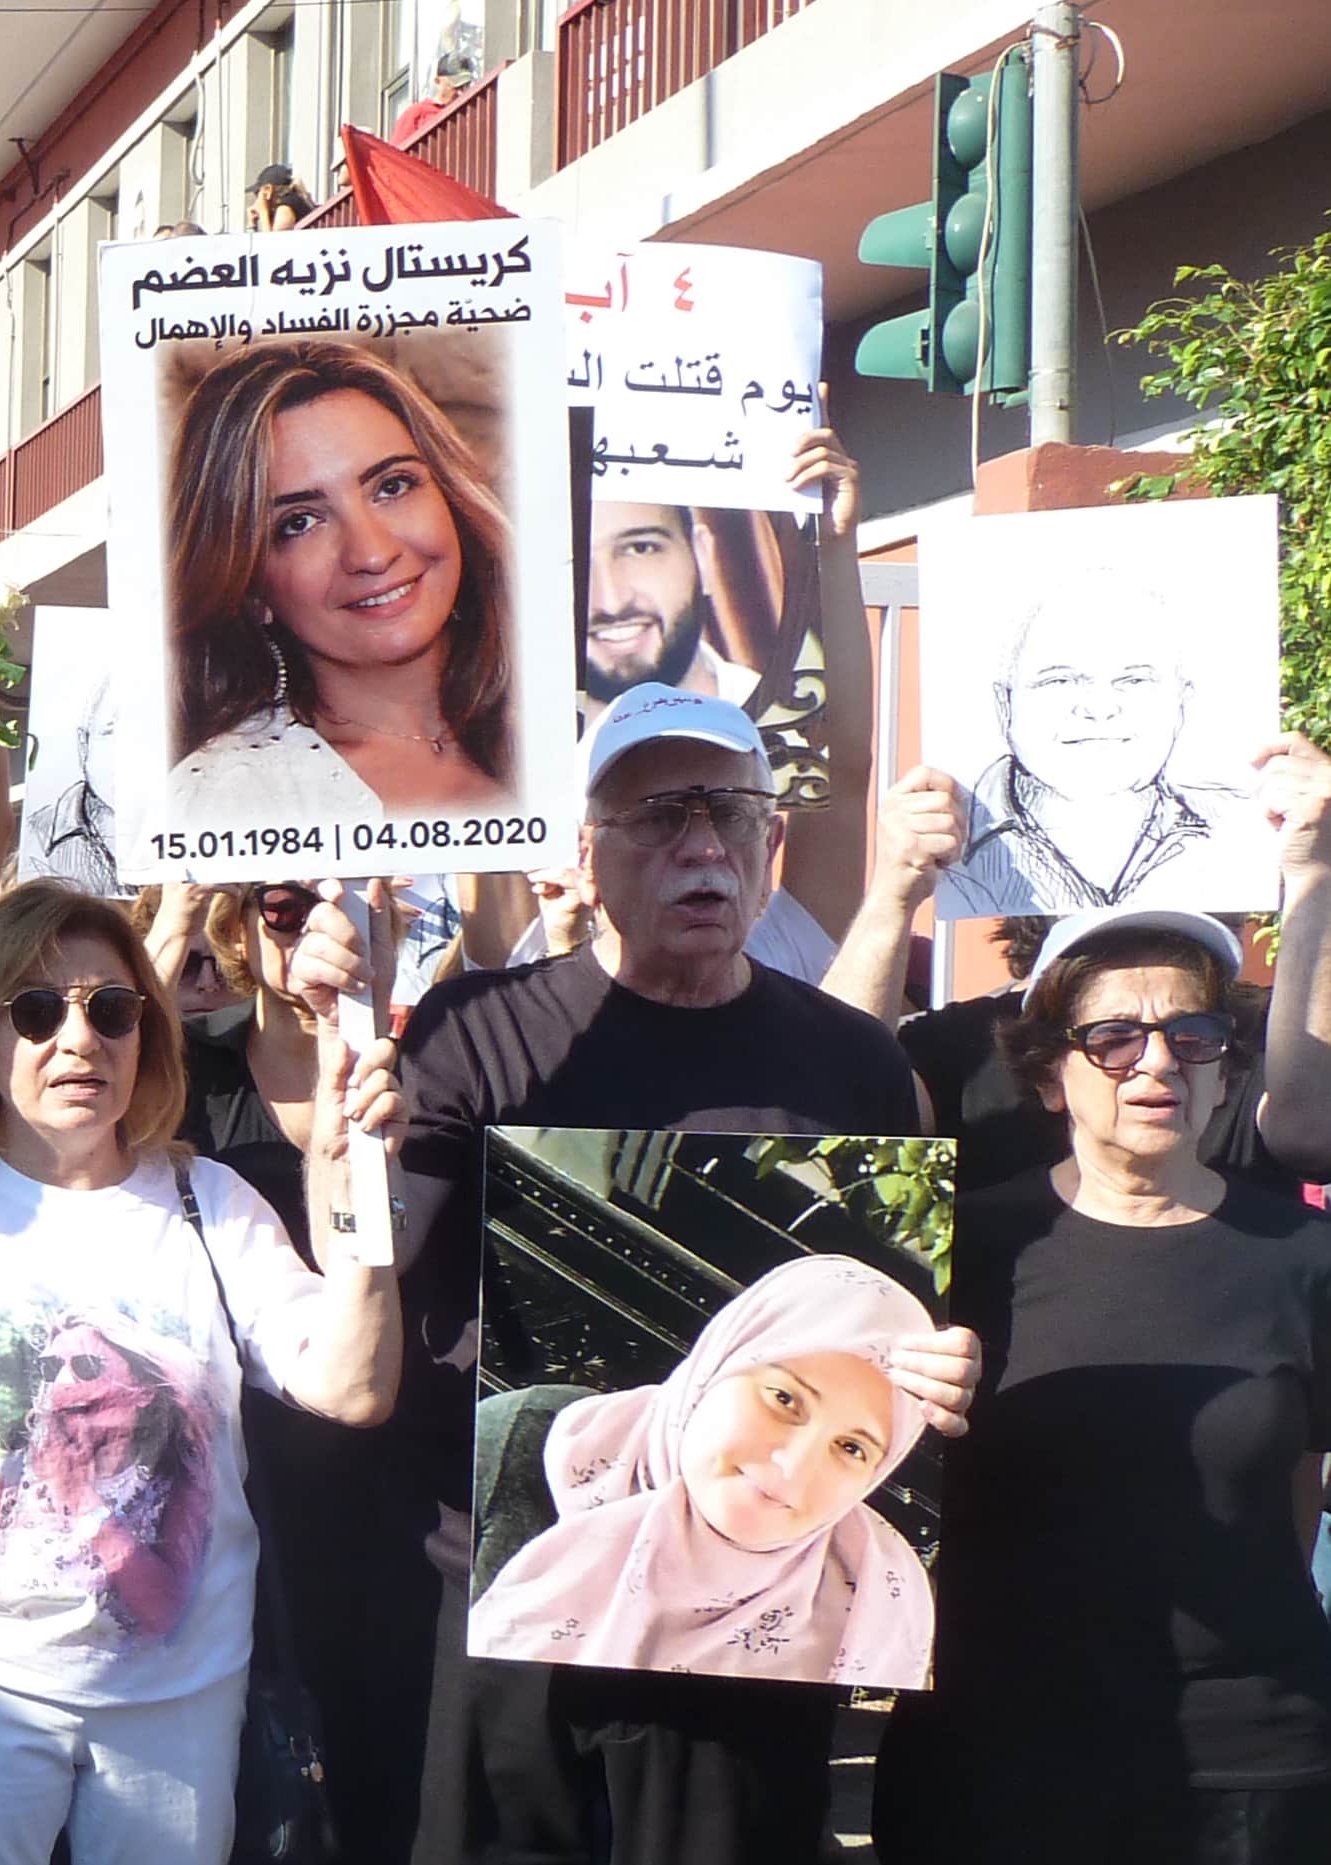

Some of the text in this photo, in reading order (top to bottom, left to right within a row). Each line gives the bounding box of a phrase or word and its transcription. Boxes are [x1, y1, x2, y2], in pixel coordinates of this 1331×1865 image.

[132, 235, 532, 311] كريستال نزيه العضم
[673, 266, 695, 312] ٤
[134, 313, 253, 352] والإهمال
[261, 307, 350, 336] الفساد
[356, 304, 440, 338] مجزرة
[624, 352, 723, 396] قتلت
[740, 380, 814, 417] يوم
[590, 430, 744, 478] شعبه
[150, 826, 324, 860] 15.01.1984
[353, 817, 547, 851] 04.08.2020
